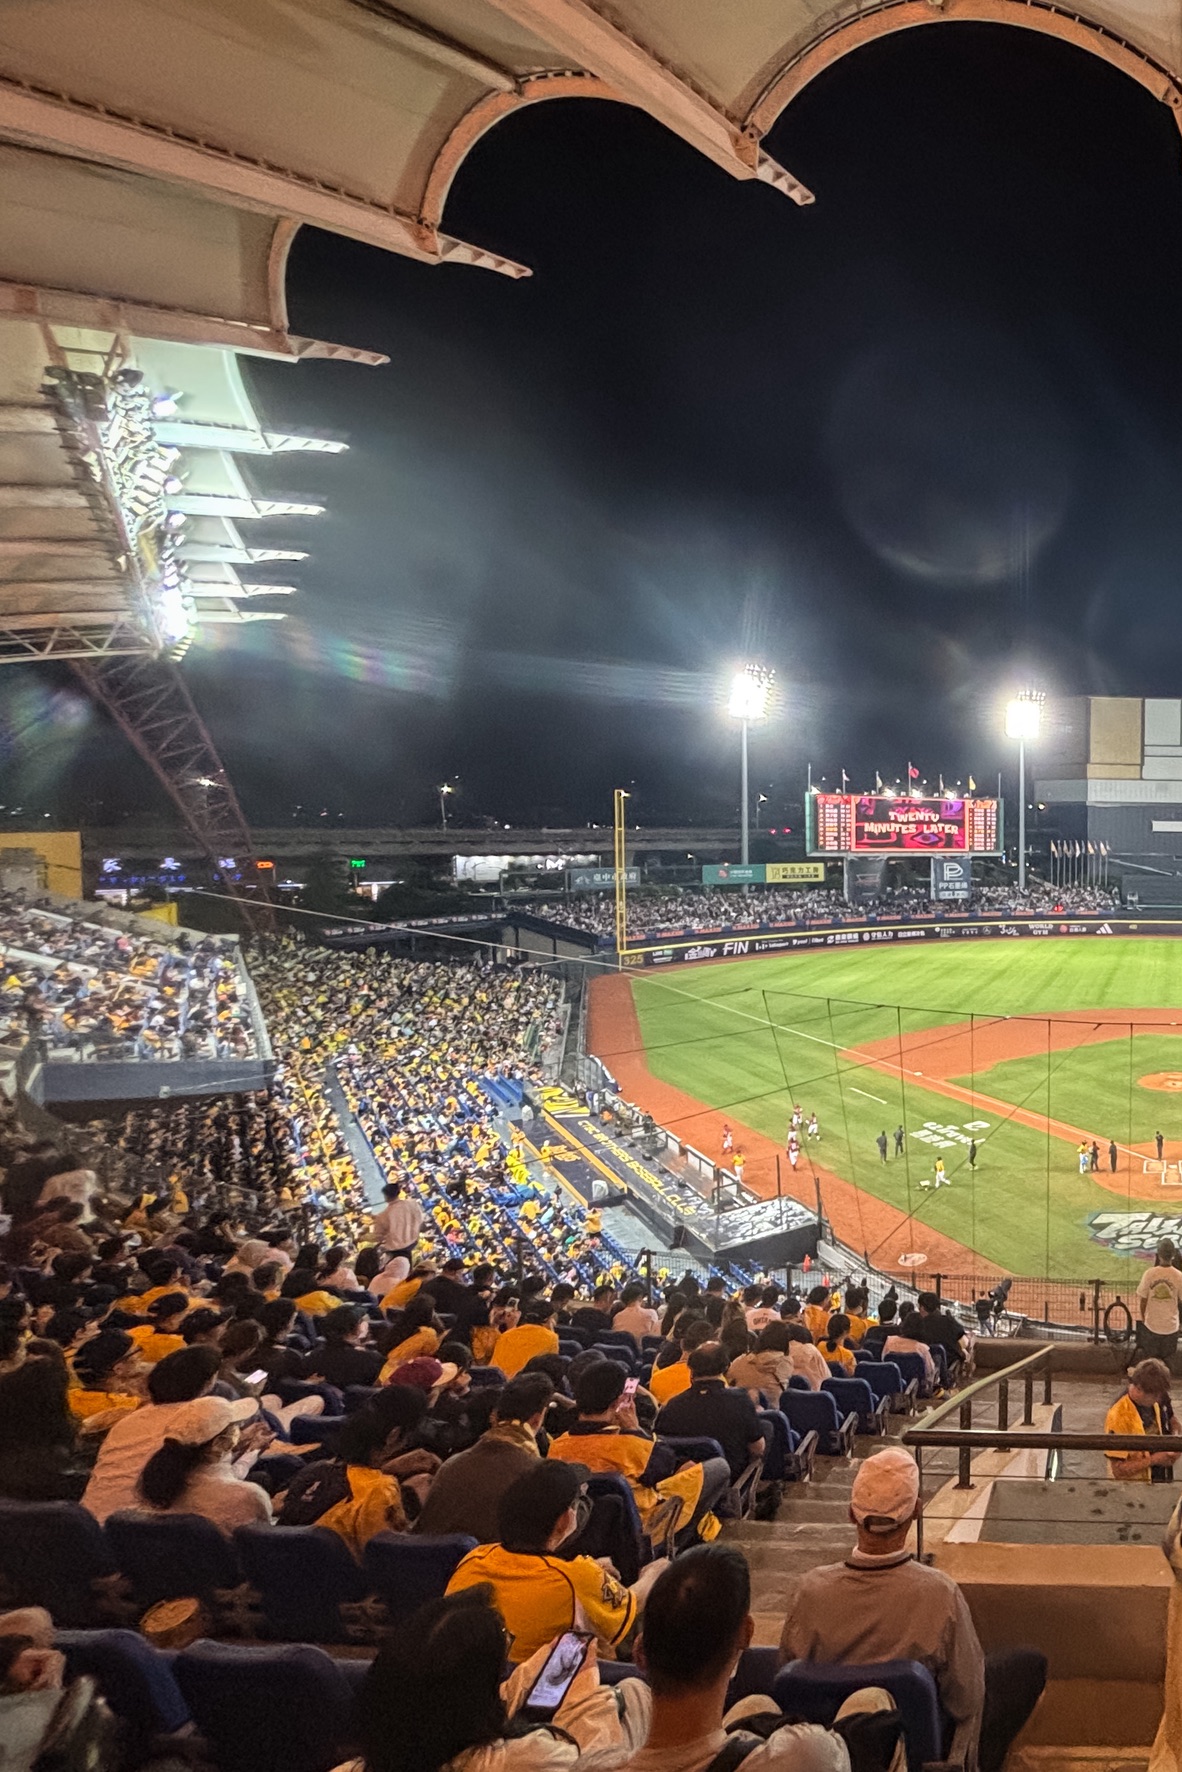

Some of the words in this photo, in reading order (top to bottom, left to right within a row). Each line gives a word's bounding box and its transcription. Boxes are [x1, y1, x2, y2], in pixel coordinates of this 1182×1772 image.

[864, 823, 917, 835] MINUTES
[923, 823, 959, 836] LATER
[722, 941, 750, 957] FIN
[623, 955, 644, 966] 325
